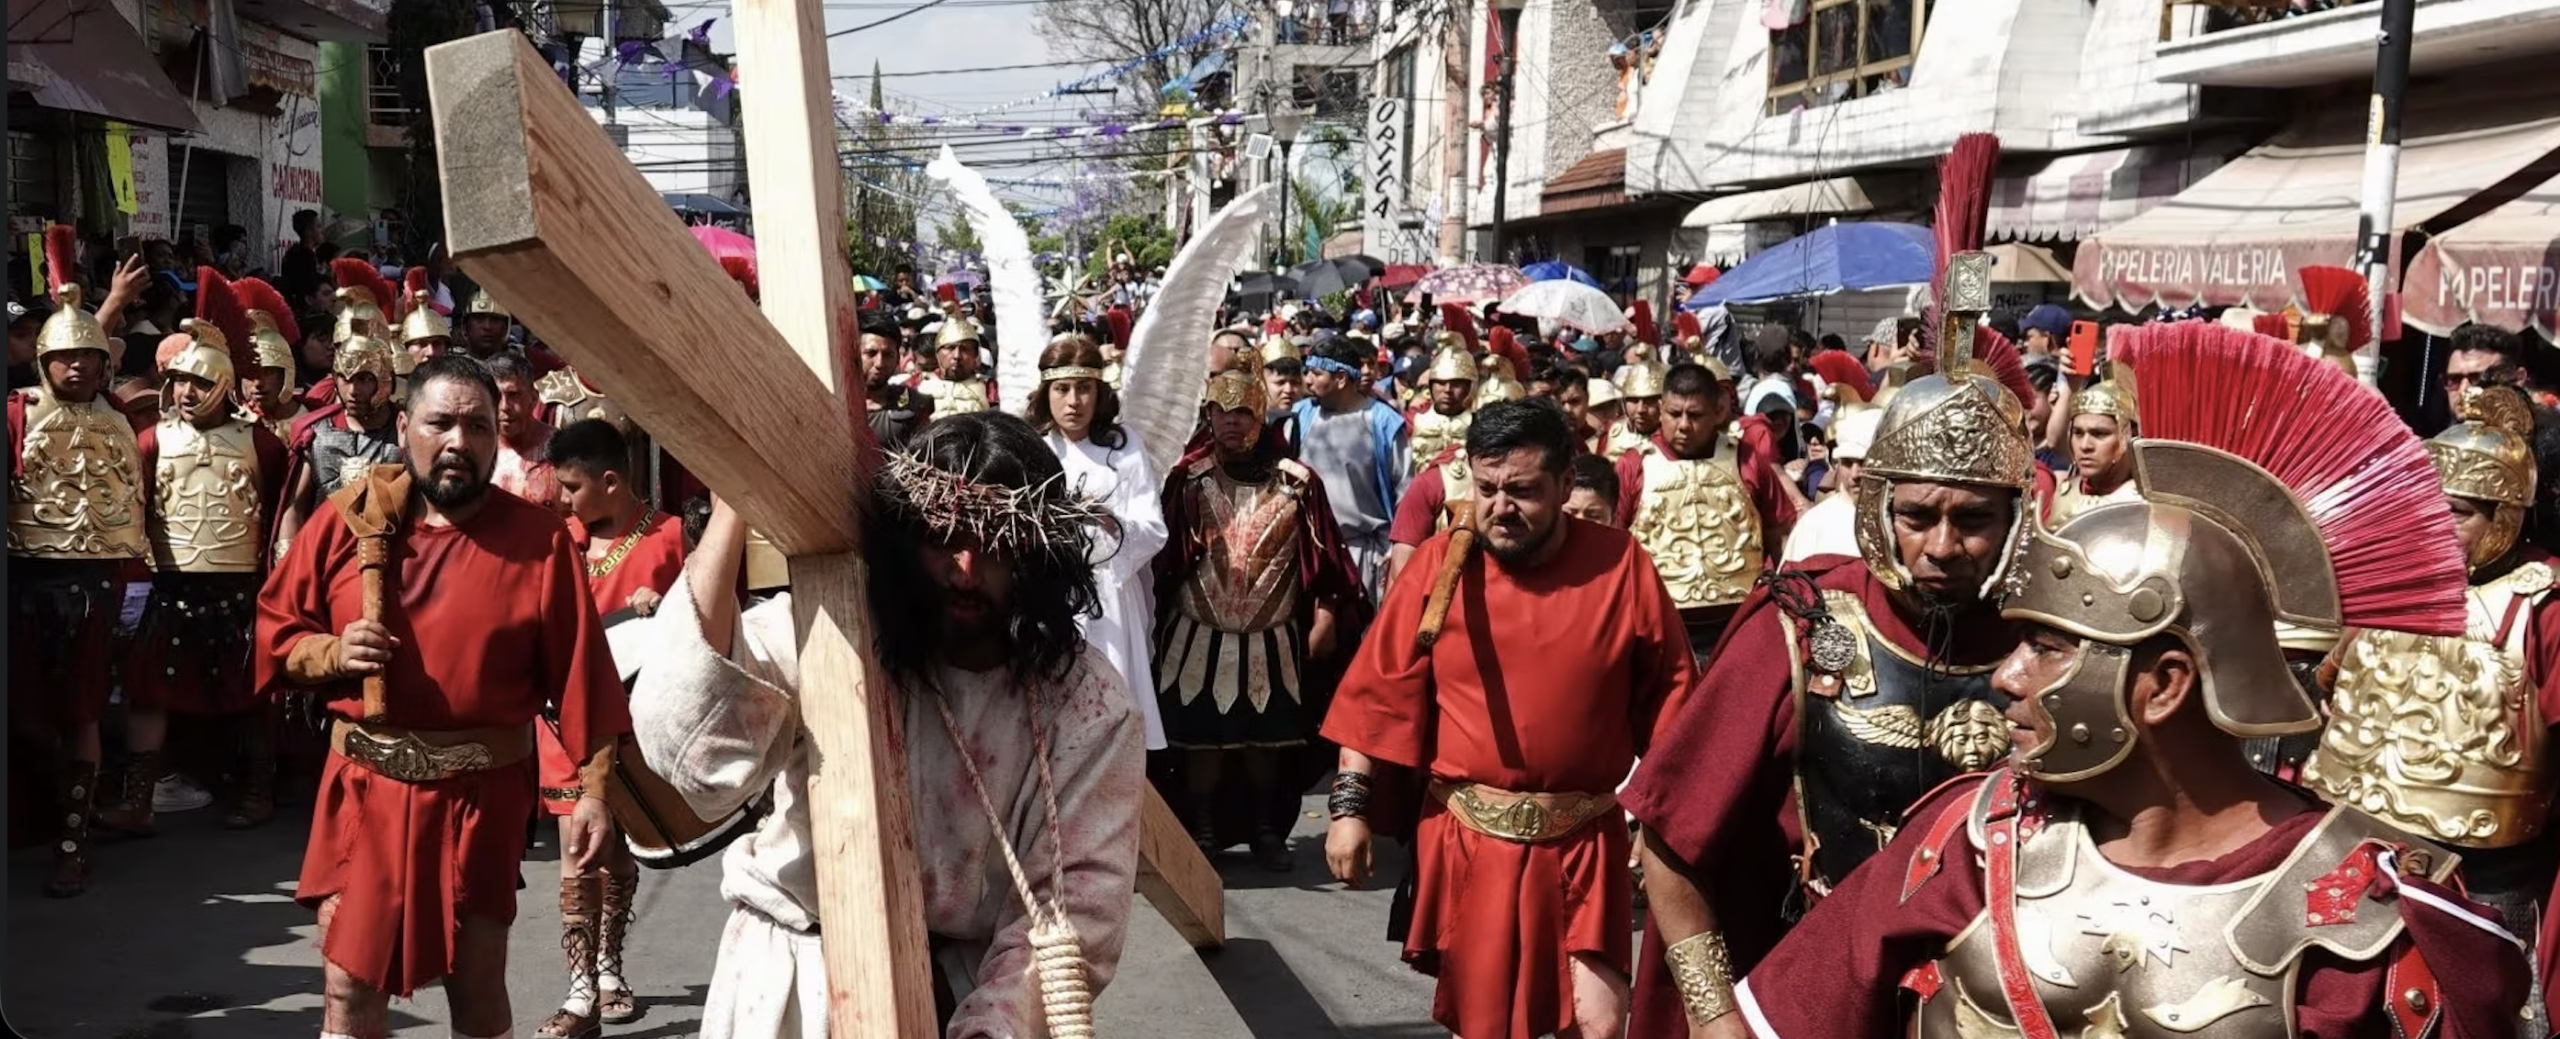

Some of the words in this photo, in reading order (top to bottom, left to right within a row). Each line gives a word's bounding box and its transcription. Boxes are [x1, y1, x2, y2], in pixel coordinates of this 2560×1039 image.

[1372, 100, 1396, 218] OPTICA
[1389, 248, 1410, 264] DE
[2097, 249, 2192, 284] PAPELERIA
[2200, 248, 2287, 285] VALERIA
